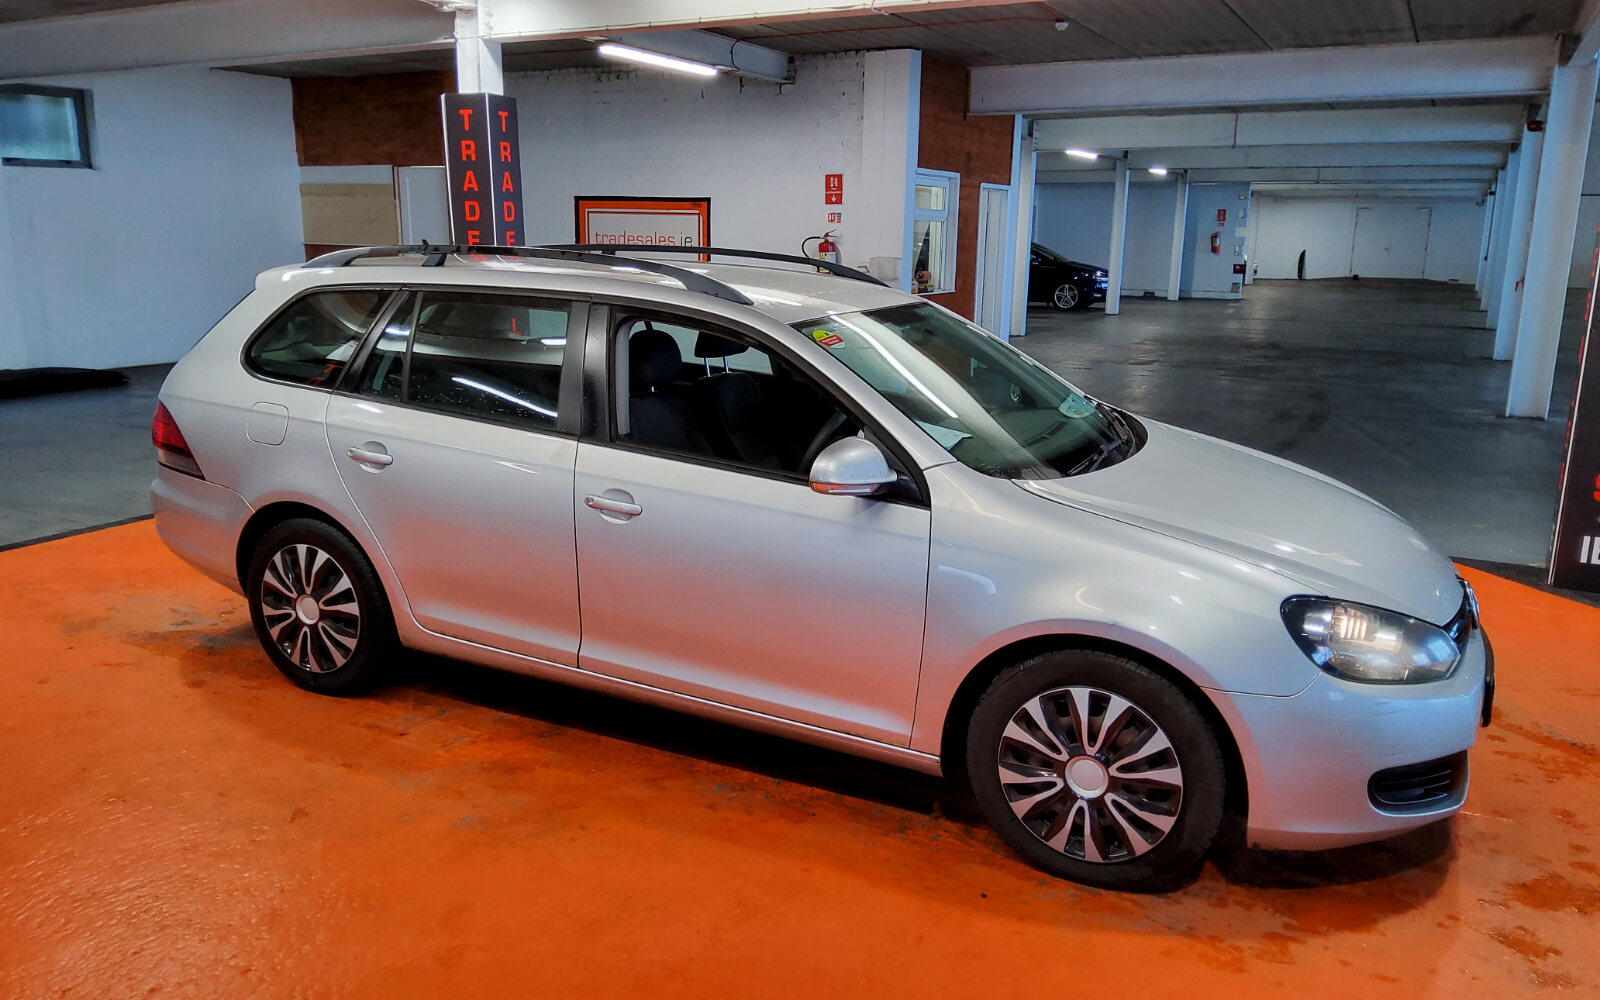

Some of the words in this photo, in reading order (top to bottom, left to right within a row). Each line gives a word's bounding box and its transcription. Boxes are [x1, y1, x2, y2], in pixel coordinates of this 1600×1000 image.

[458, 109, 481, 246] TRADE
[498, 111, 516, 246] TRADE
[595, 230, 693, 247] tradesalesie
